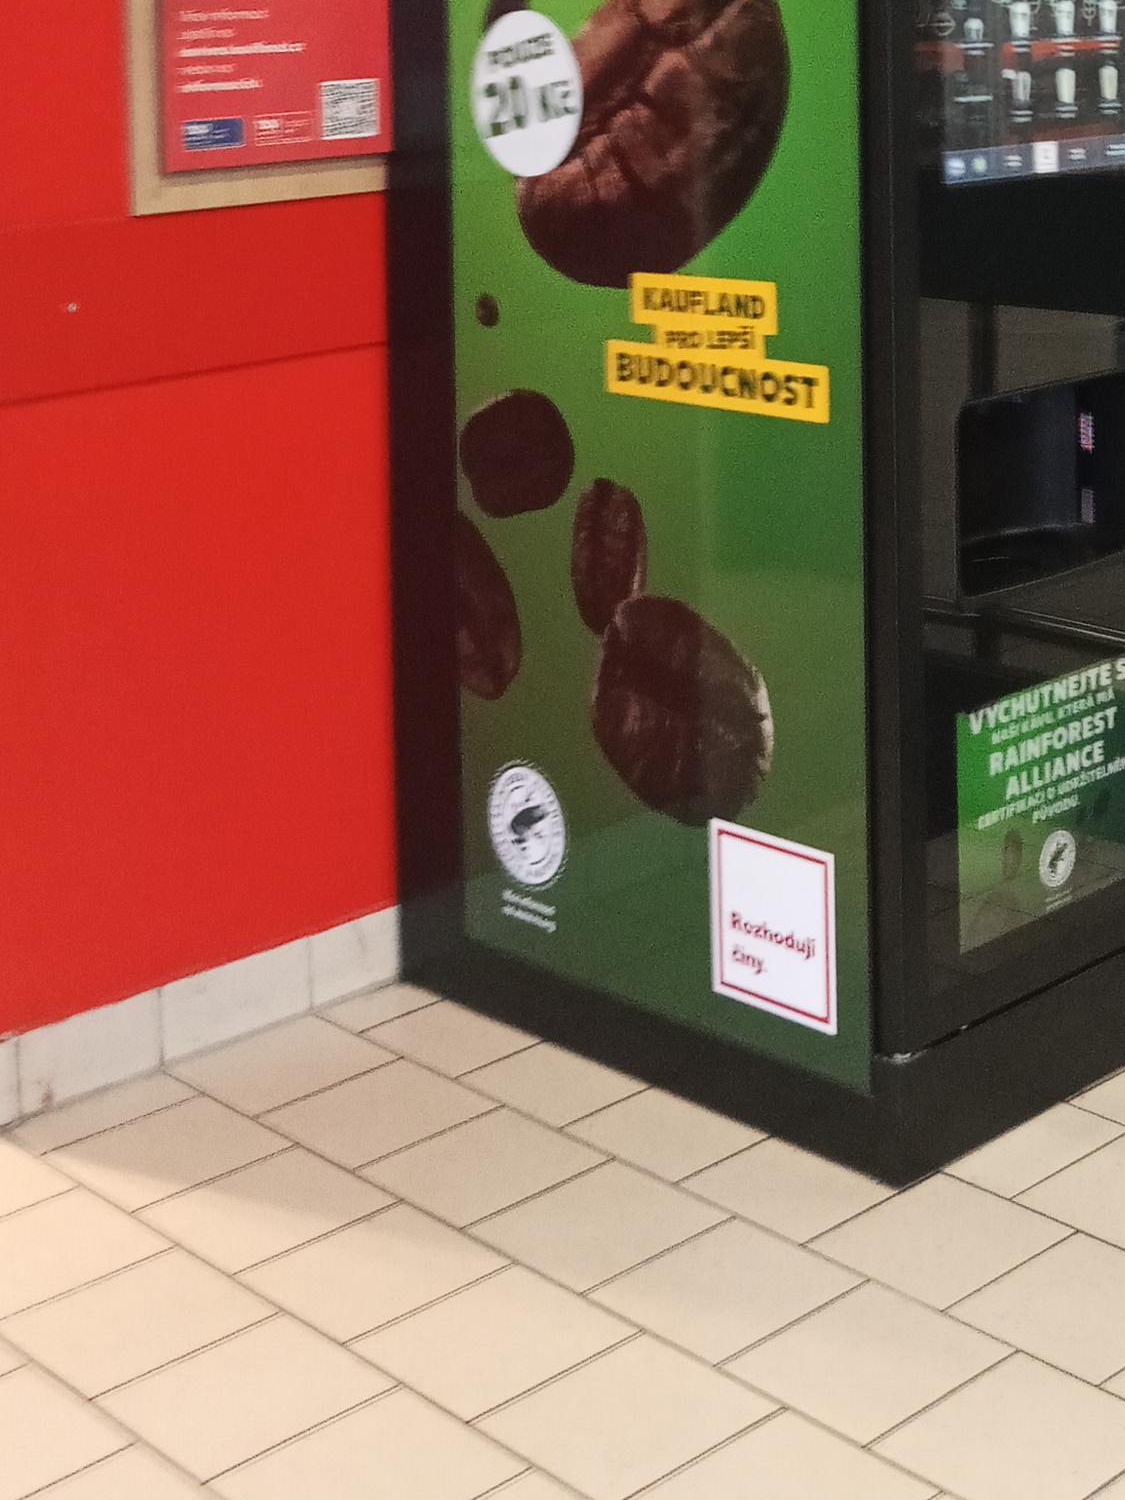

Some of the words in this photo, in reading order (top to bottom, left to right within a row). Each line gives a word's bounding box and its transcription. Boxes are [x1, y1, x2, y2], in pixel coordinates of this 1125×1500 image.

[642, 287, 766, 320] KAUFLAND
[664, 330, 704, 350] PRO
[615, 352, 820, 408] BUDOUCNOST
[968, 662, 1114, 735] VYCHUTNEJTE
[988, 705, 1118, 776] RAINFOREST
[1005, 740, 1106, 800] ALLIANCE
[731, 911, 816, 960] Rozhodují
